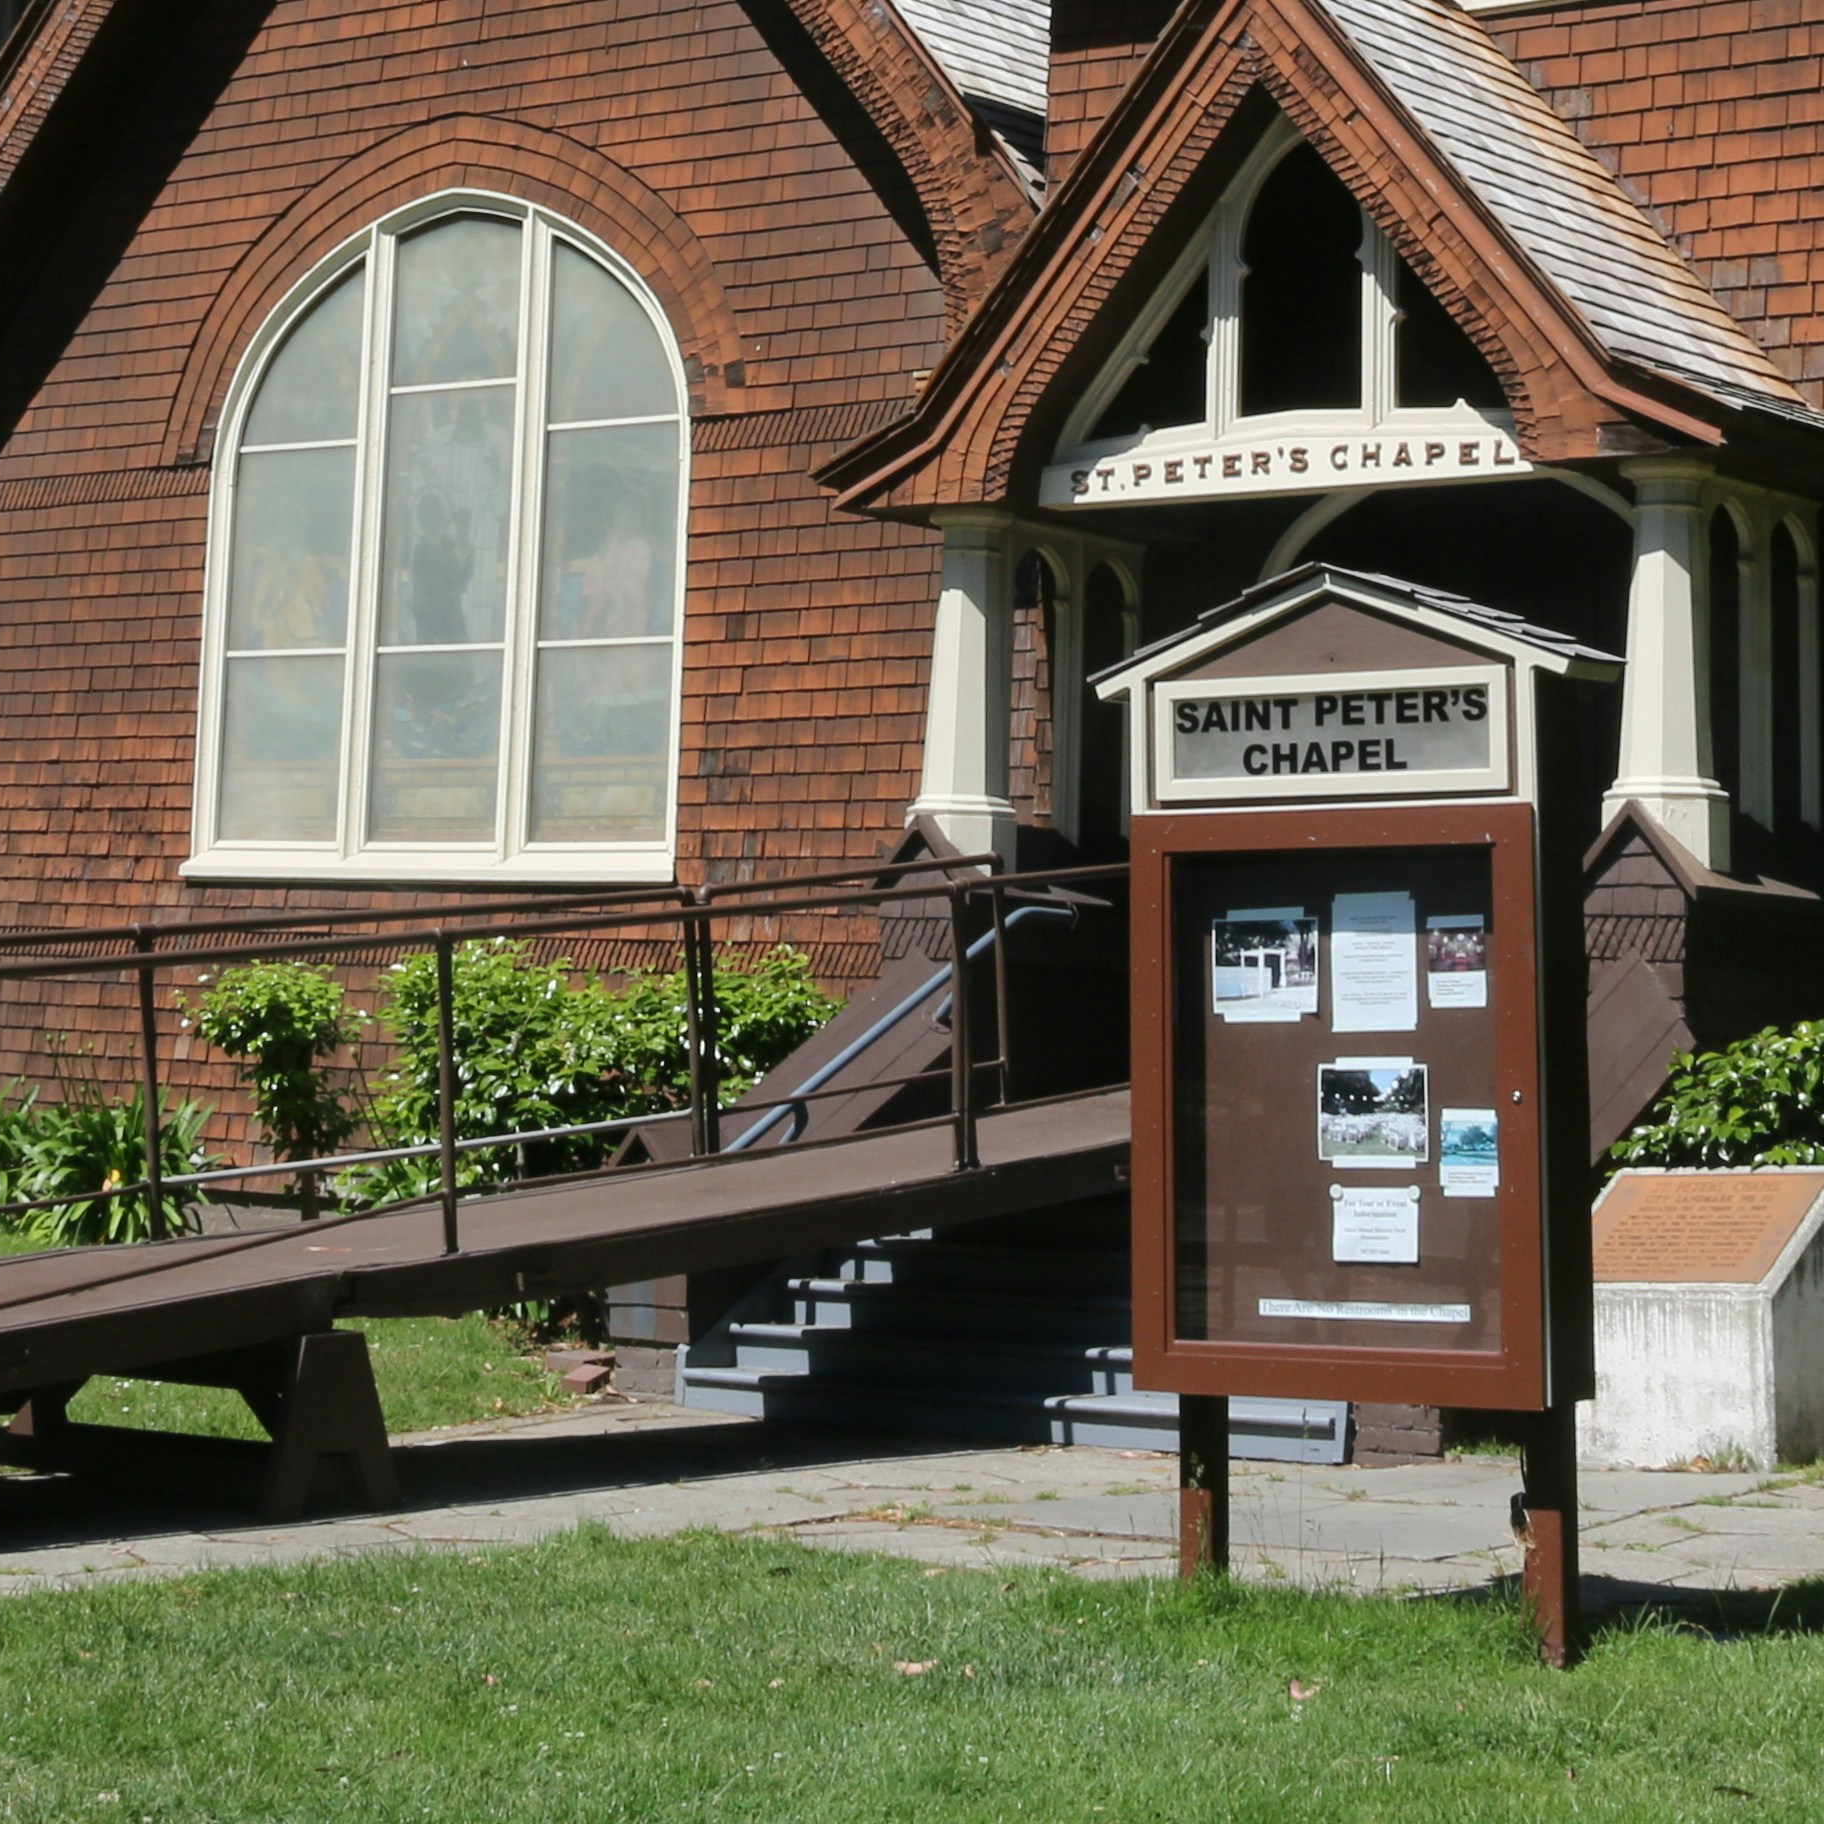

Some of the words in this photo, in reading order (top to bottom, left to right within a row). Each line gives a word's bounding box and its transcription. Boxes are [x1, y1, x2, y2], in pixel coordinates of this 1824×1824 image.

[1330, 439, 1515, 471] CHAPEL
[1176, 698, 1299, 734] SAINT
[1314, 687, 1488, 727] PETER'S
[1242, 738, 1408, 775] CHAPEL
[1262, 1301, 1291, 1313] There
[1293, 1302, 1313, 1314] Are
[1317, 1303, 1334, 1314] No
[1336, 1303, 1393, 1316] Restrooms
[1410, 1305, 1428, 1317] the
[1430, 1305, 1469, 1321] Chapel
